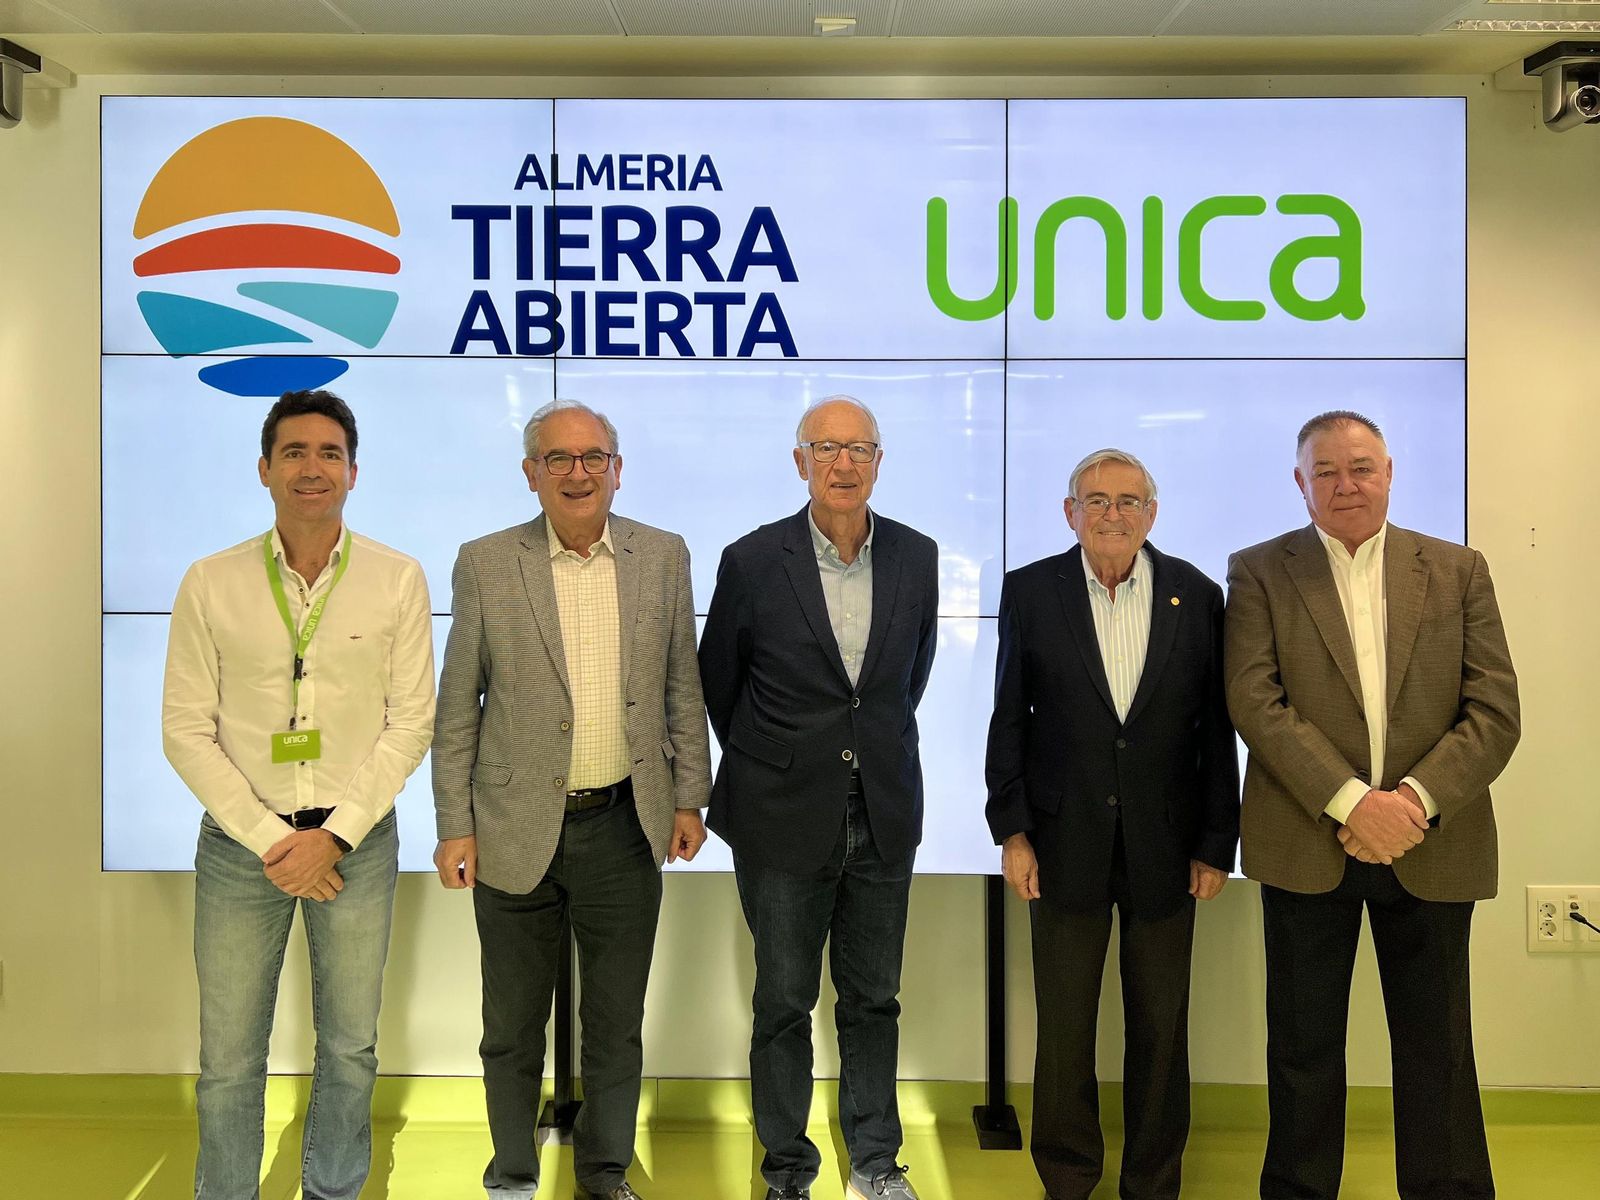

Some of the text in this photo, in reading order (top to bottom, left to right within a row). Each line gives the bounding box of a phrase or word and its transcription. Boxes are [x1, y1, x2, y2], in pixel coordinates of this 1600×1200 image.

[514, 153, 723, 191] ALMERIA
[451, 204, 799, 282] TIERRA
[449, 289, 799, 357] ABIERTA
